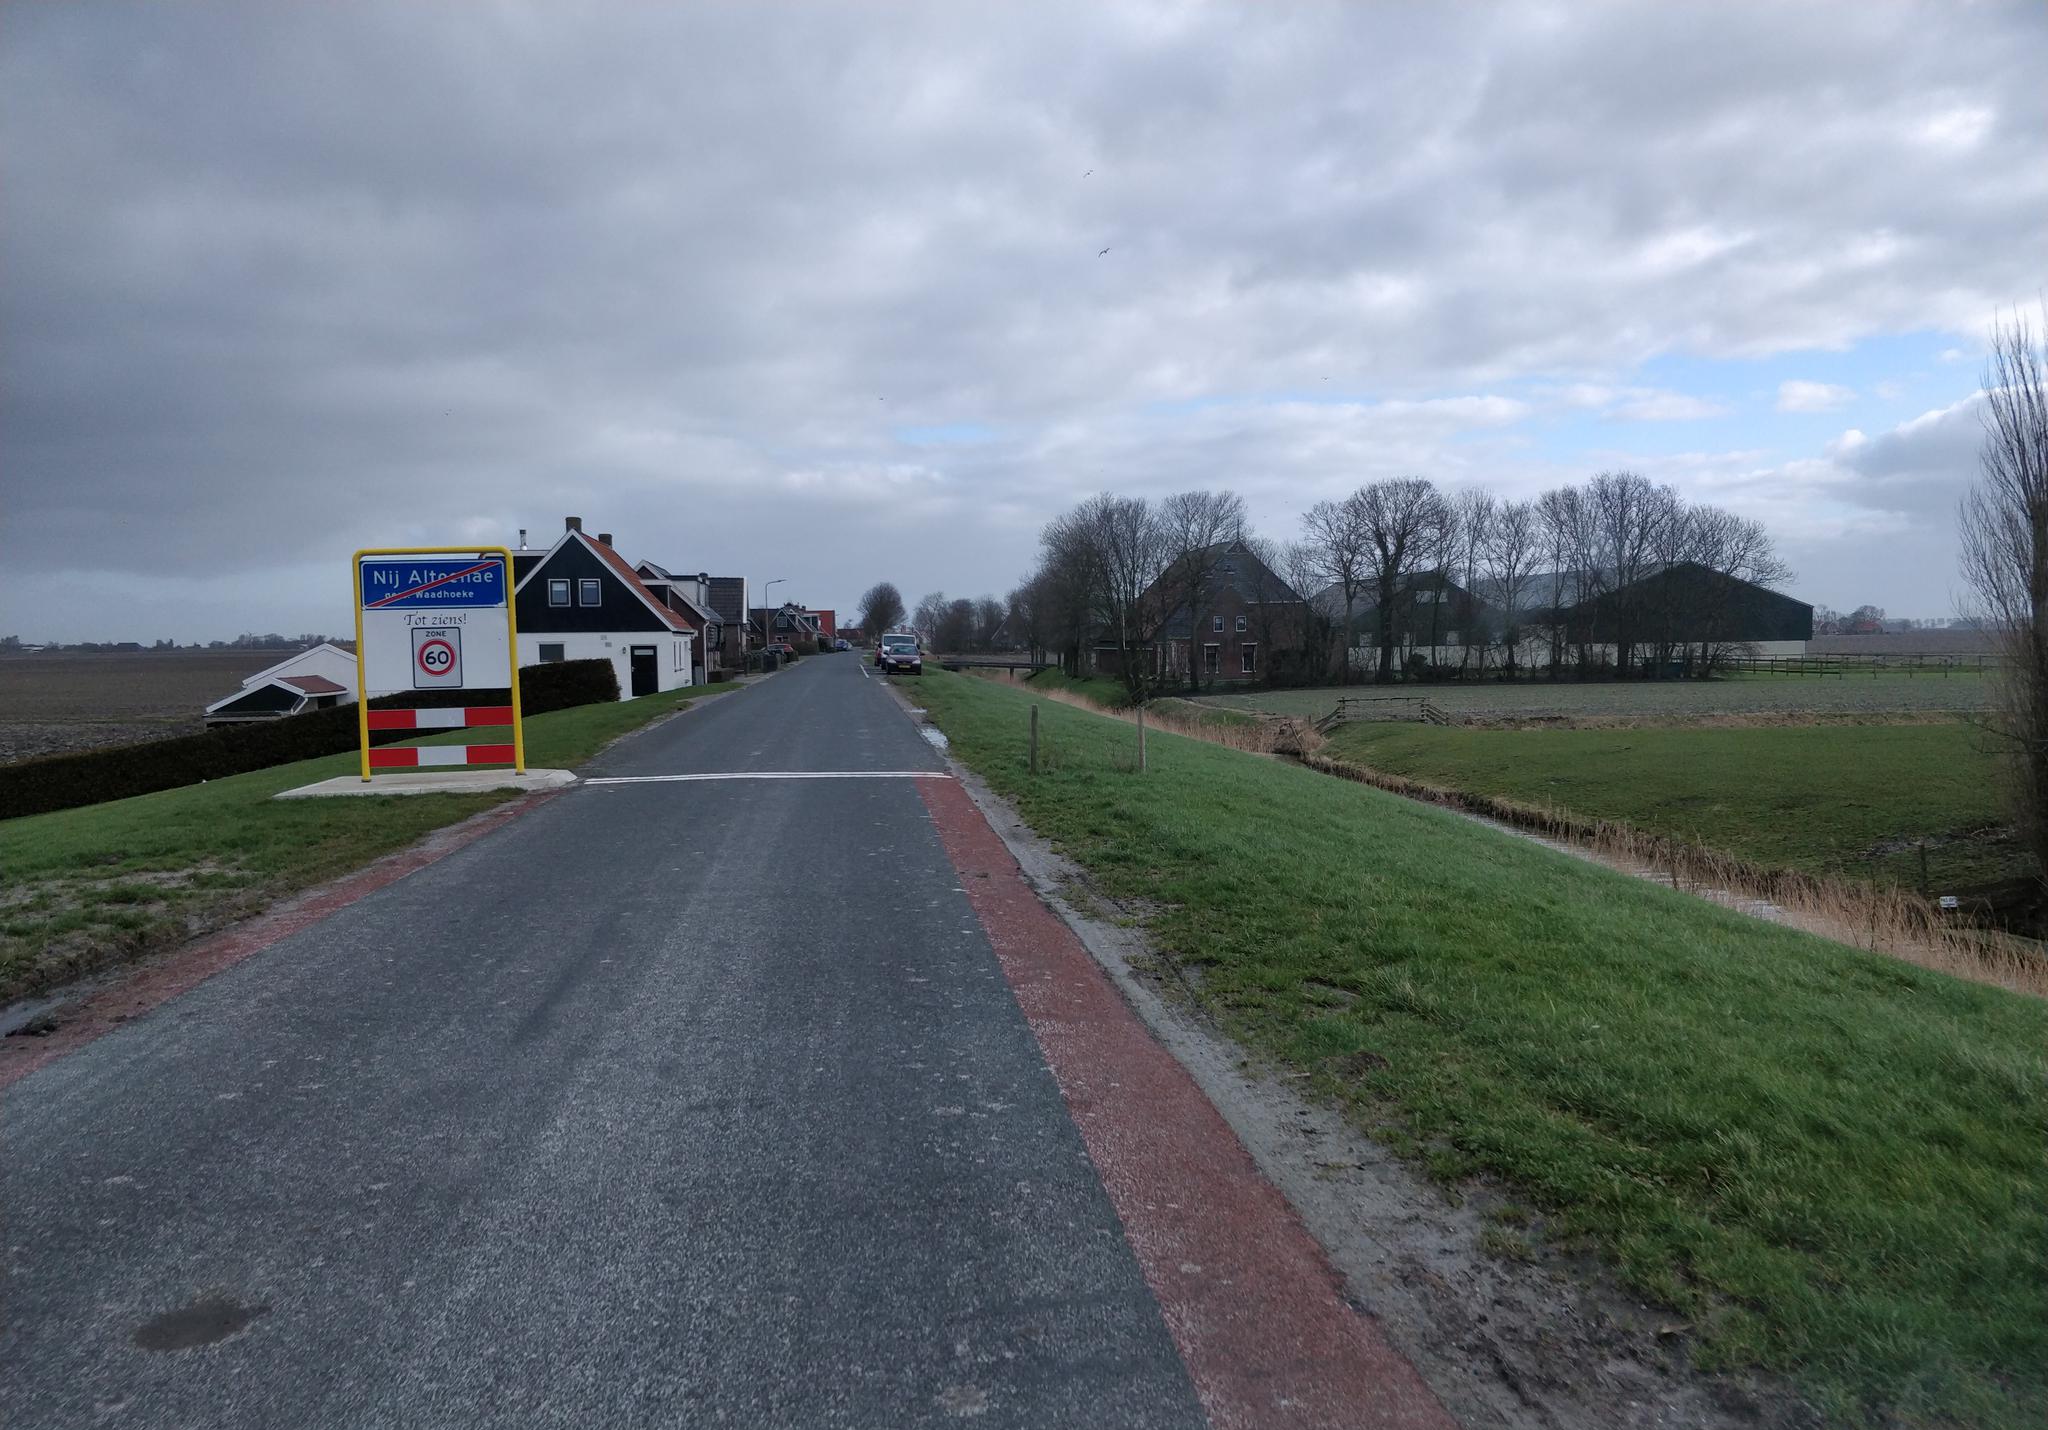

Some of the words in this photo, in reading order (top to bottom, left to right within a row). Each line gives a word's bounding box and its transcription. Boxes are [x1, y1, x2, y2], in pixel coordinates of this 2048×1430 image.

[373, 570, 399, 588] Nij
[415, 590, 474, 599] Waadhoeke
[403, 611, 427, 625] Tot
[432, 613, 467, 625] ziens!
[425, 650, 449, 665] 60
